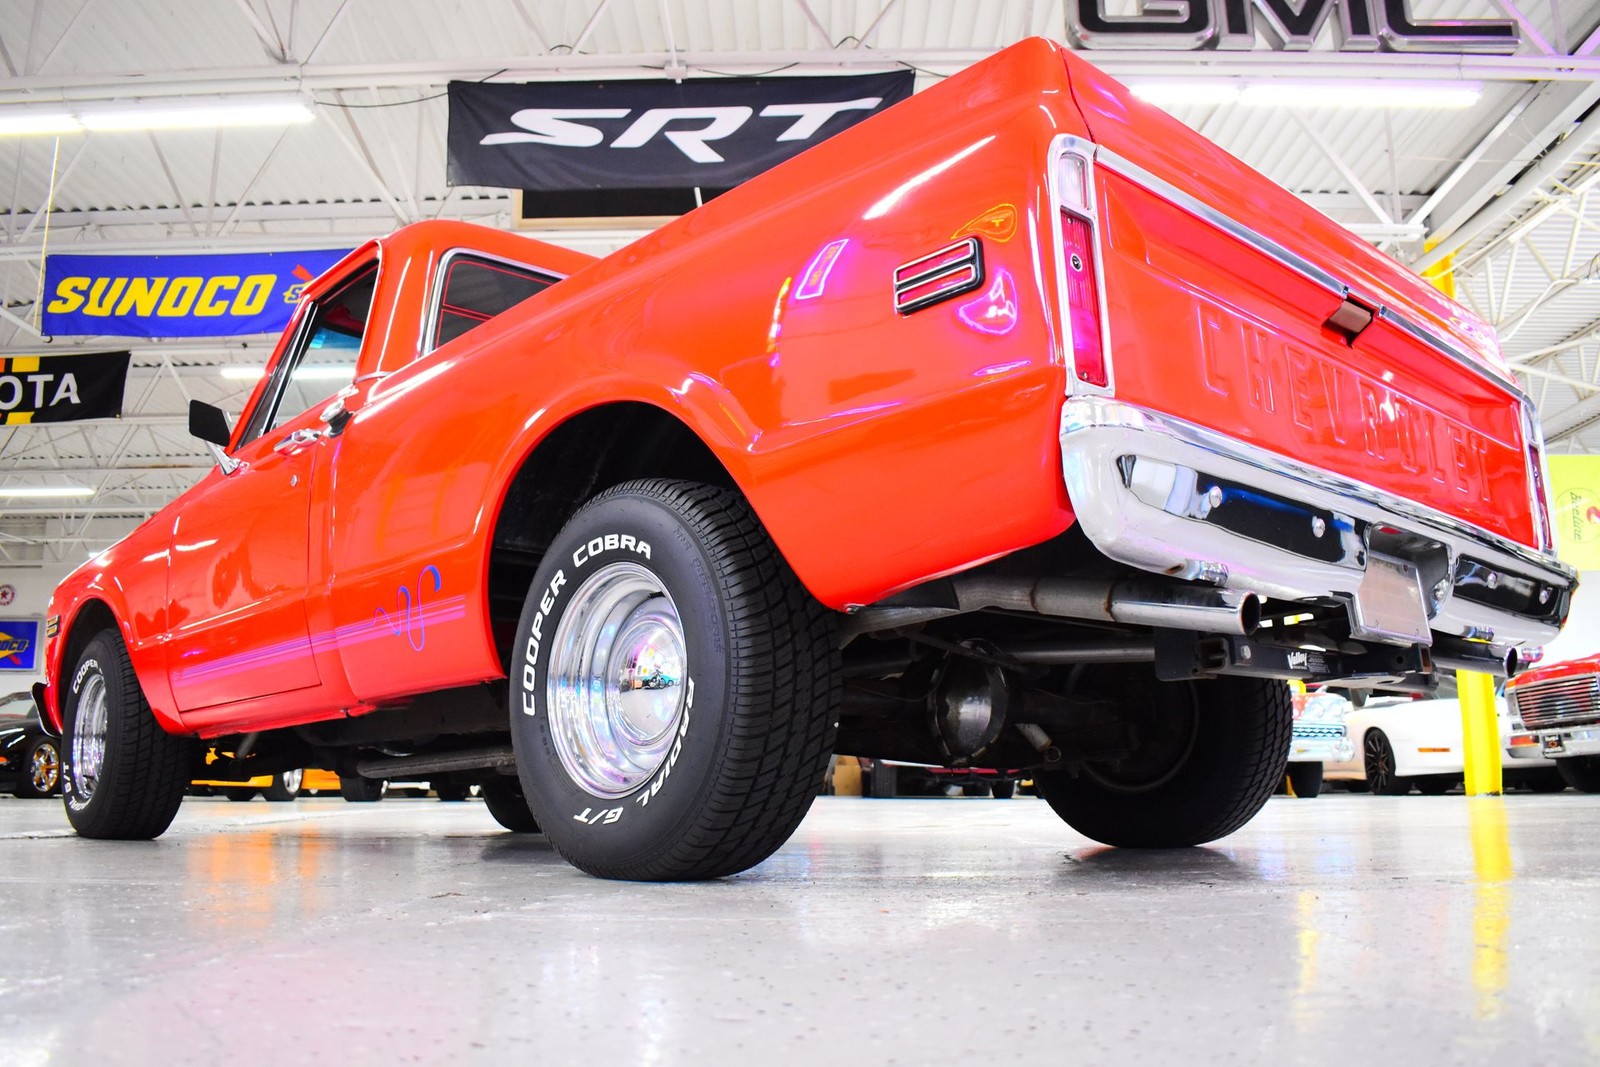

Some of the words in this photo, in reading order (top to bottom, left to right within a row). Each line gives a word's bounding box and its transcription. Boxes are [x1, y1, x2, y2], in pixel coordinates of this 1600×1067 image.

[480, 97, 883, 164] SRT
[47, 274, 278, 317] SUNOCO
[0, 373, 81, 411] OTA
[1197, 303, 1492, 502] CHEVROLET
[523, 569, 567, 717] COOPER
[572, 533, 652, 568] COBRA
[72, 658, 99, 694] COOPER
[636, 677, 695, 807] RADIAL
[573, 806, 624, 825] G/T
